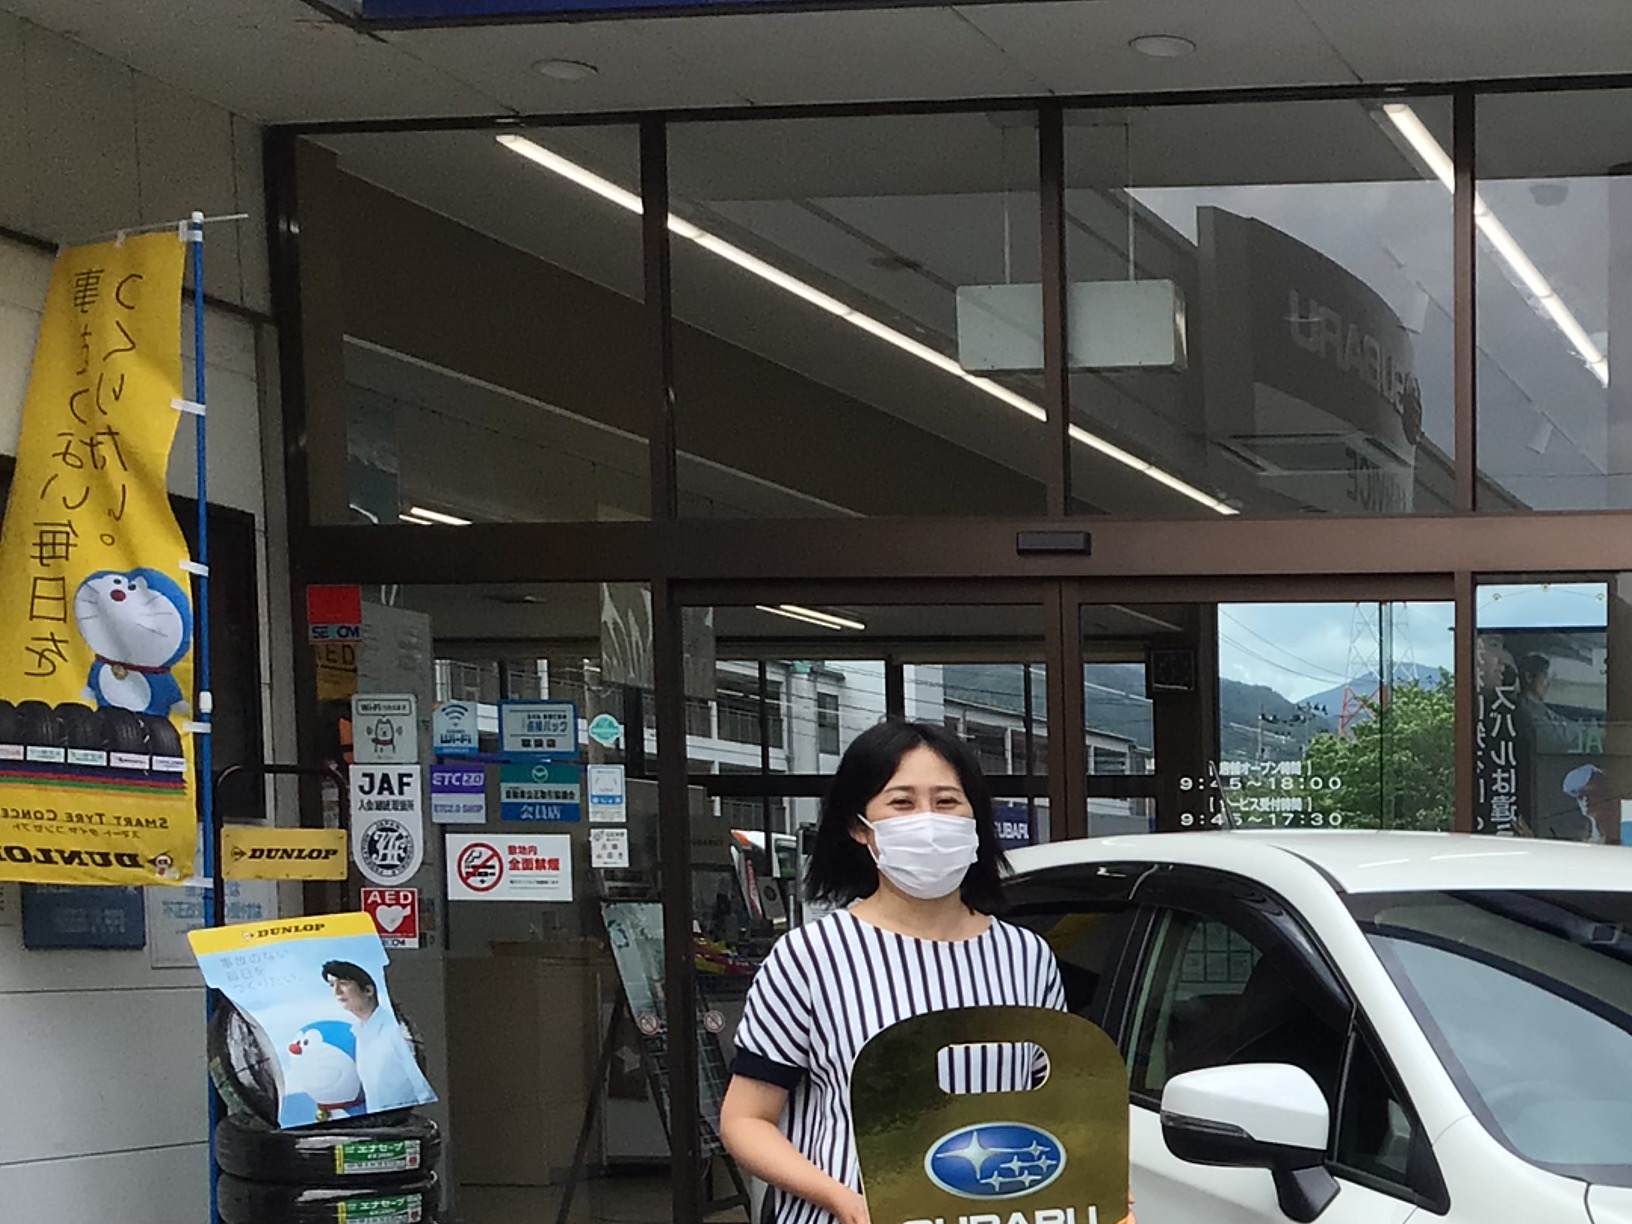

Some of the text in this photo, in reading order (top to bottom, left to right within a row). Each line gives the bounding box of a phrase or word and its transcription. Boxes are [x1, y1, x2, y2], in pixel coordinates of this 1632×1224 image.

[311, 625, 359, 639] SECOM
[440, 733, 473, 745] Wi-Fi
[358, 772, 413, 796] JAF
[432, 772, 461, 786] ETC
[249, 849, 338, 860] DUNLOP
[508, 857, 560, 872] 全面禁煙
[367, 891, 412, 903] AED
[257, 923, 326, 939] DUNLOP
